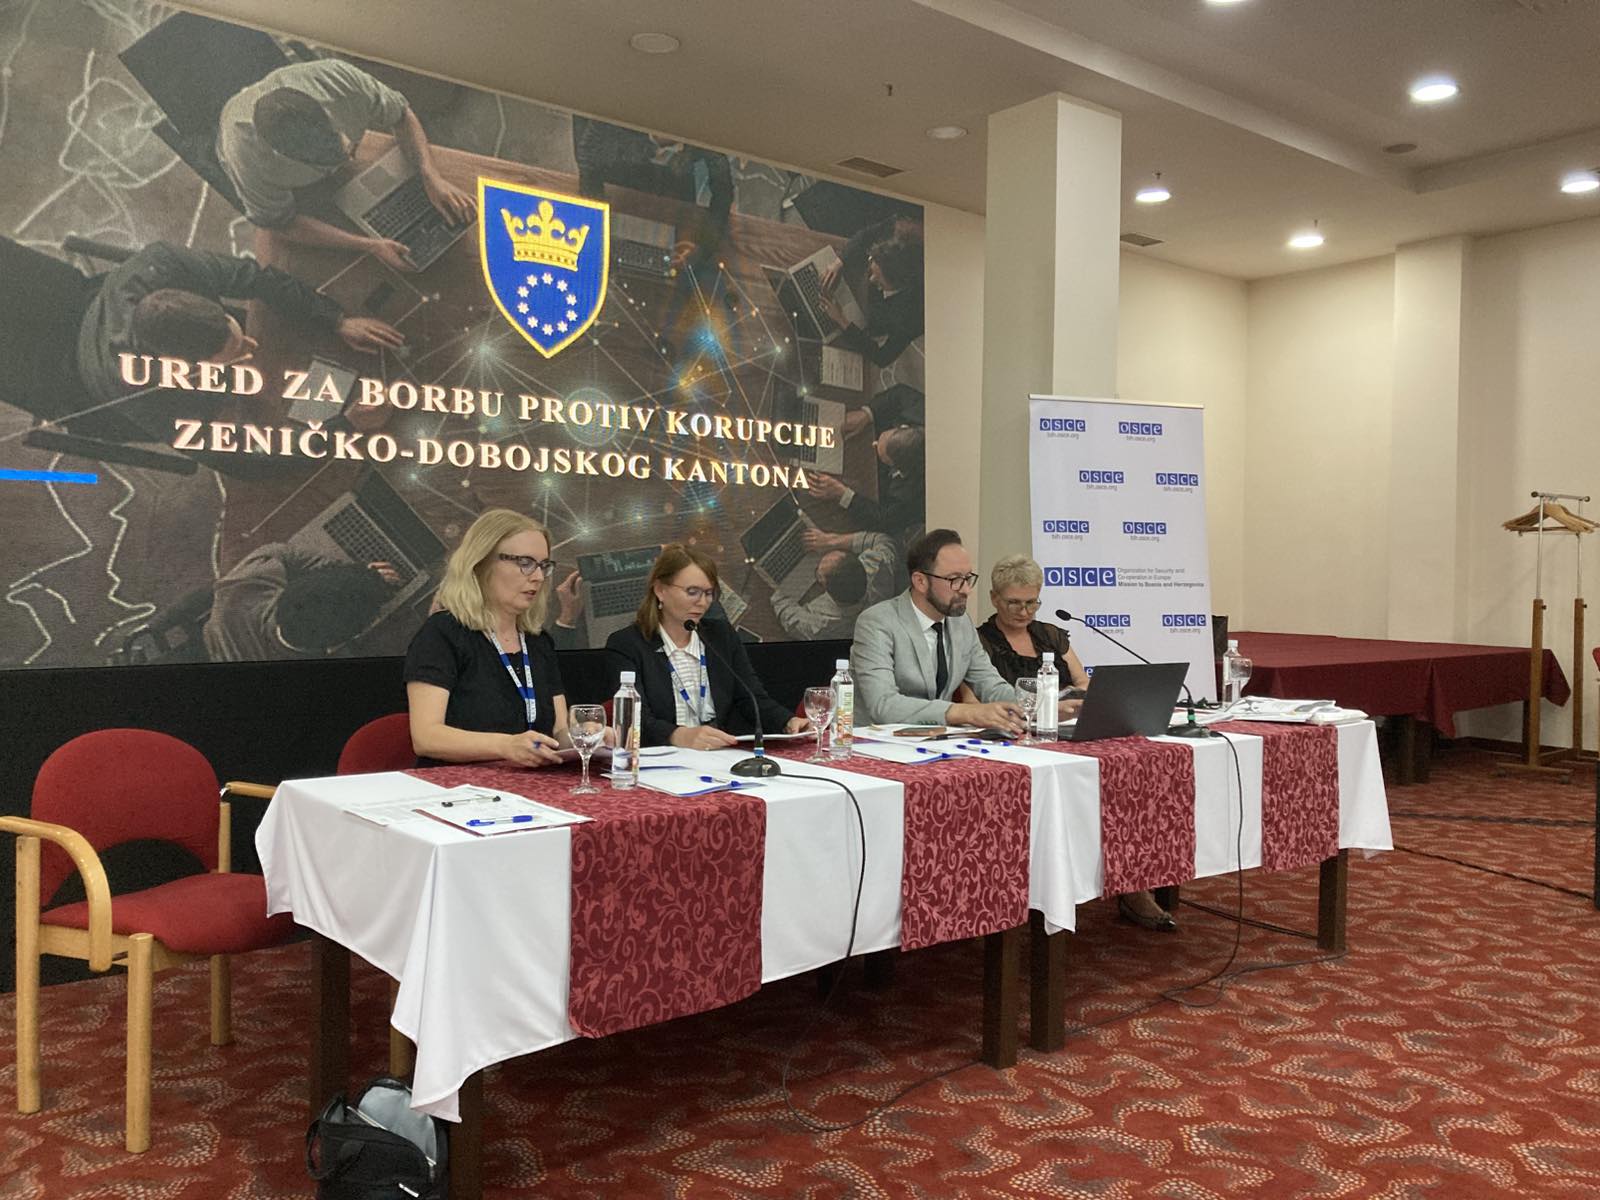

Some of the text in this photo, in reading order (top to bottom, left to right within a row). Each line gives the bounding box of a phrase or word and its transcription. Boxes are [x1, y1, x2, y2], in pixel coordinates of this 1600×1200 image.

[119, 353, 835, 449] URED ZA BORBU PROTIV KORUPCIJE
[1040, 418, 1086, 432] osce
[1119, 422, 1162, 436] osce
[173, 418, 810, 490] ZENIČKO-DOBOJSKOG KANTONA
[1079, 470, 1124, 484] osce
[1156, 473, 1198, 486] osce
[1043, 520, 1089, 533] osce
[1123, 521, 1167, 534] osce
[1044, 567, 1116, 587] osce
[1085, 615, 1131, 627] osce
[1162, 615, 1206, 626] osce
